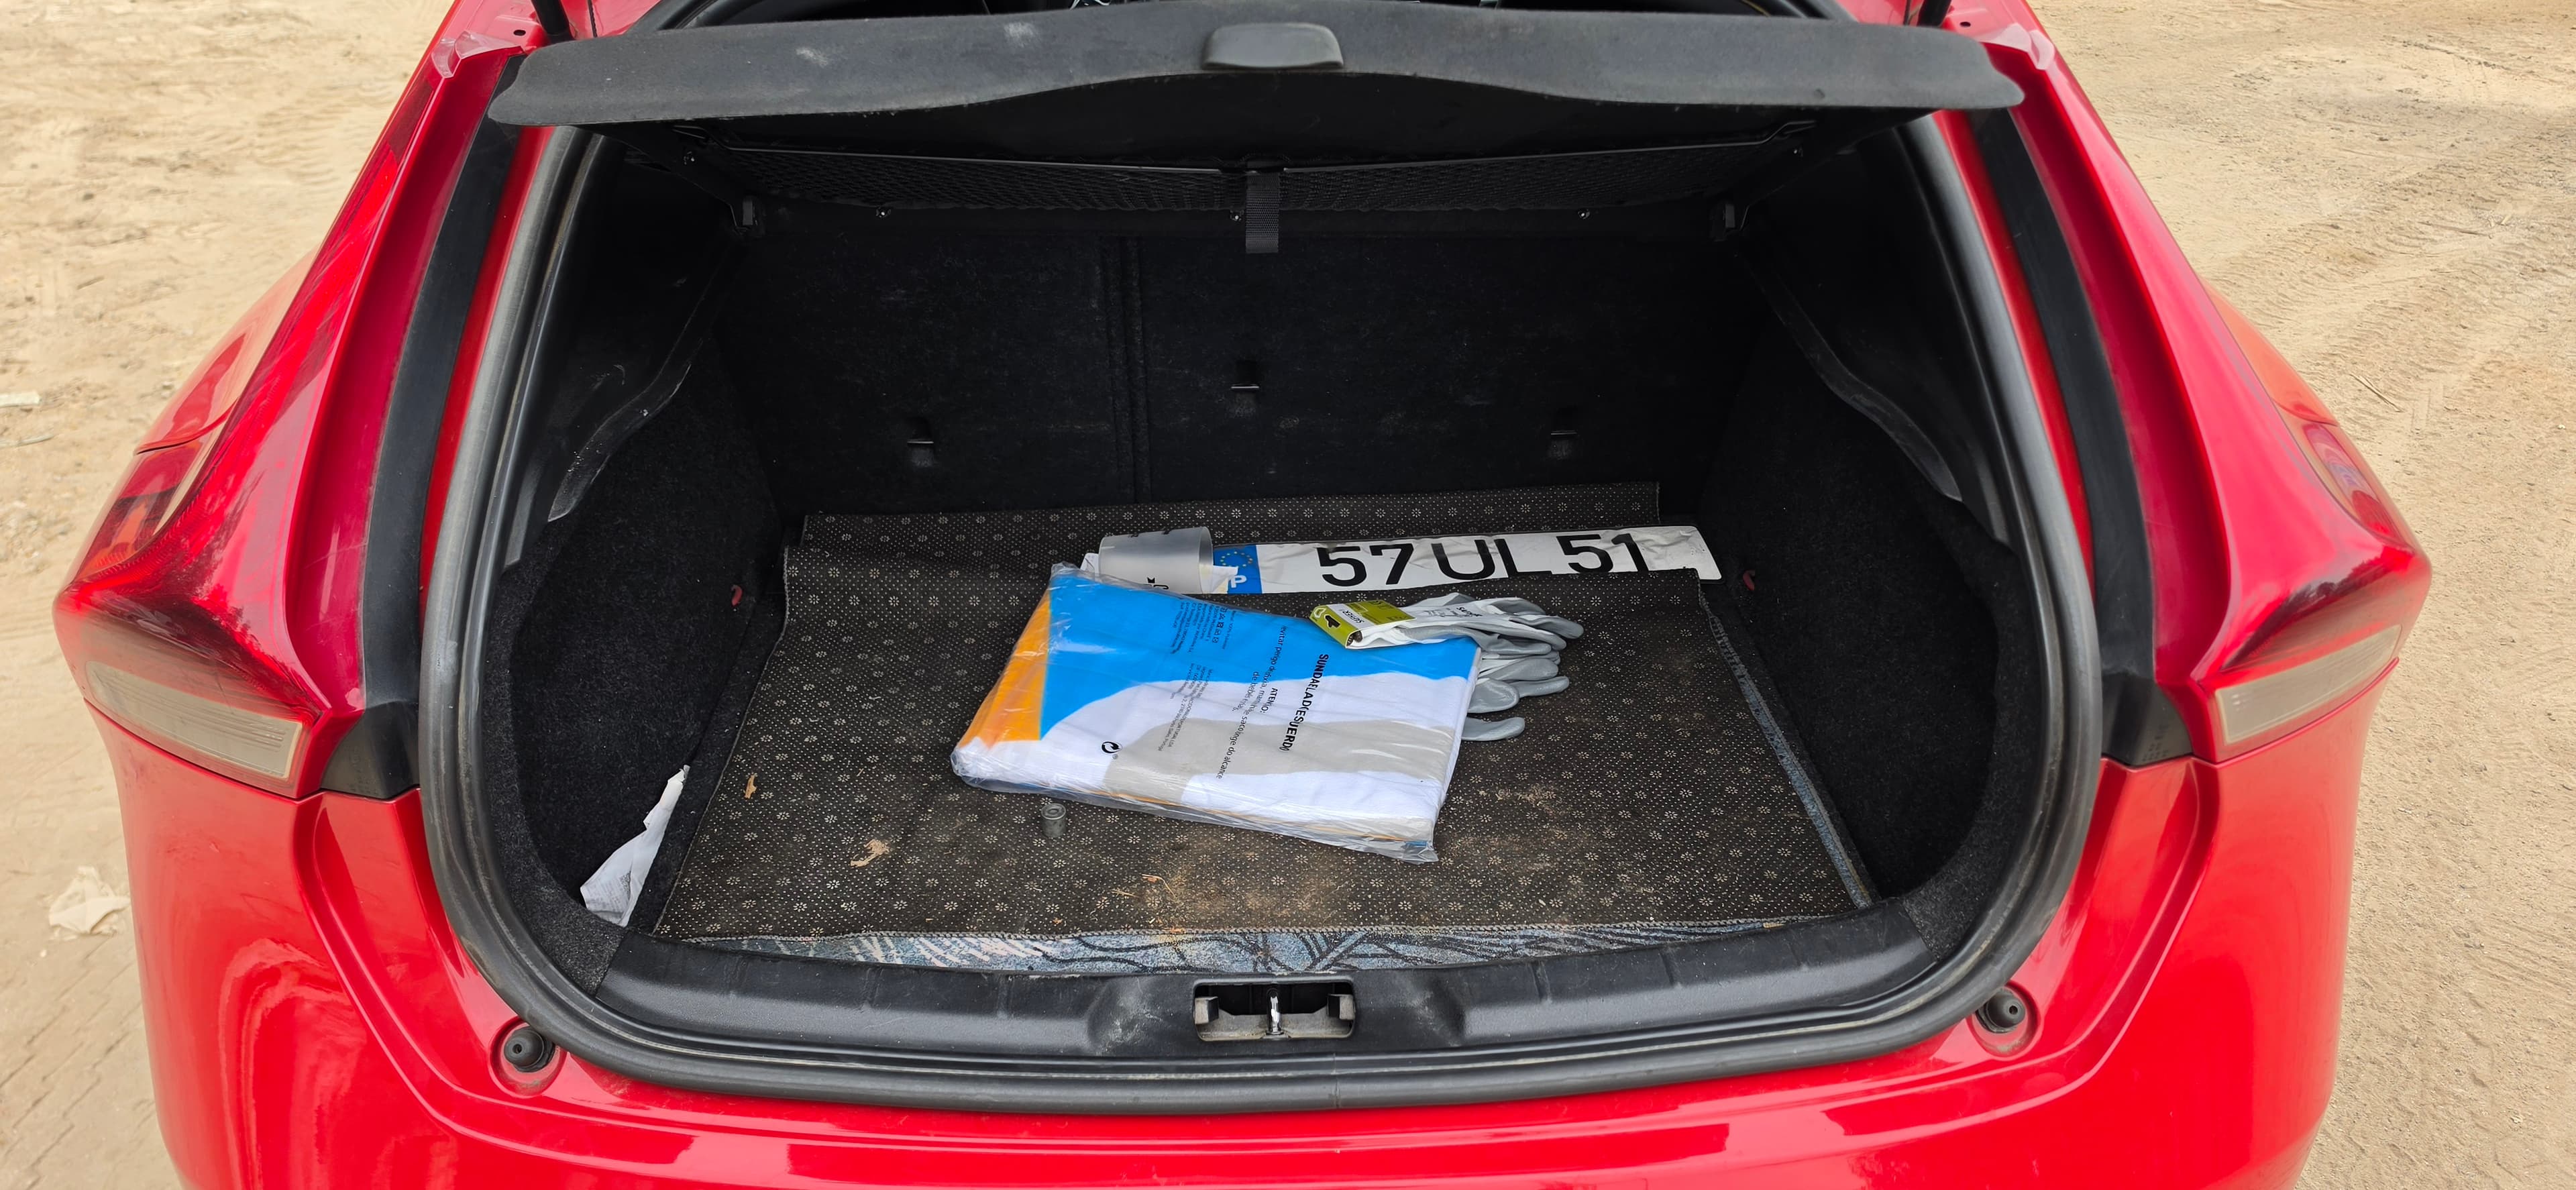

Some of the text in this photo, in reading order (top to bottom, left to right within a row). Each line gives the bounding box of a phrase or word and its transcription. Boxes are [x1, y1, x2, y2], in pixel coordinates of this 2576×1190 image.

[1317, 533, 1650, 586] 57 UL 51
[1230, 575, 1247, 588] P
[1271, 646, 1285, 665] perigo
[1251, 671, 1260, 681] de
[1307, 653, 1330, 688] SUNDAE
[1237, 716, 1249, 731] saco
[1279, 710, 1306, 751] ESUERDO
[1226, 747, 1236, 756] do
[1215, 756, 1232, 779] alcance
